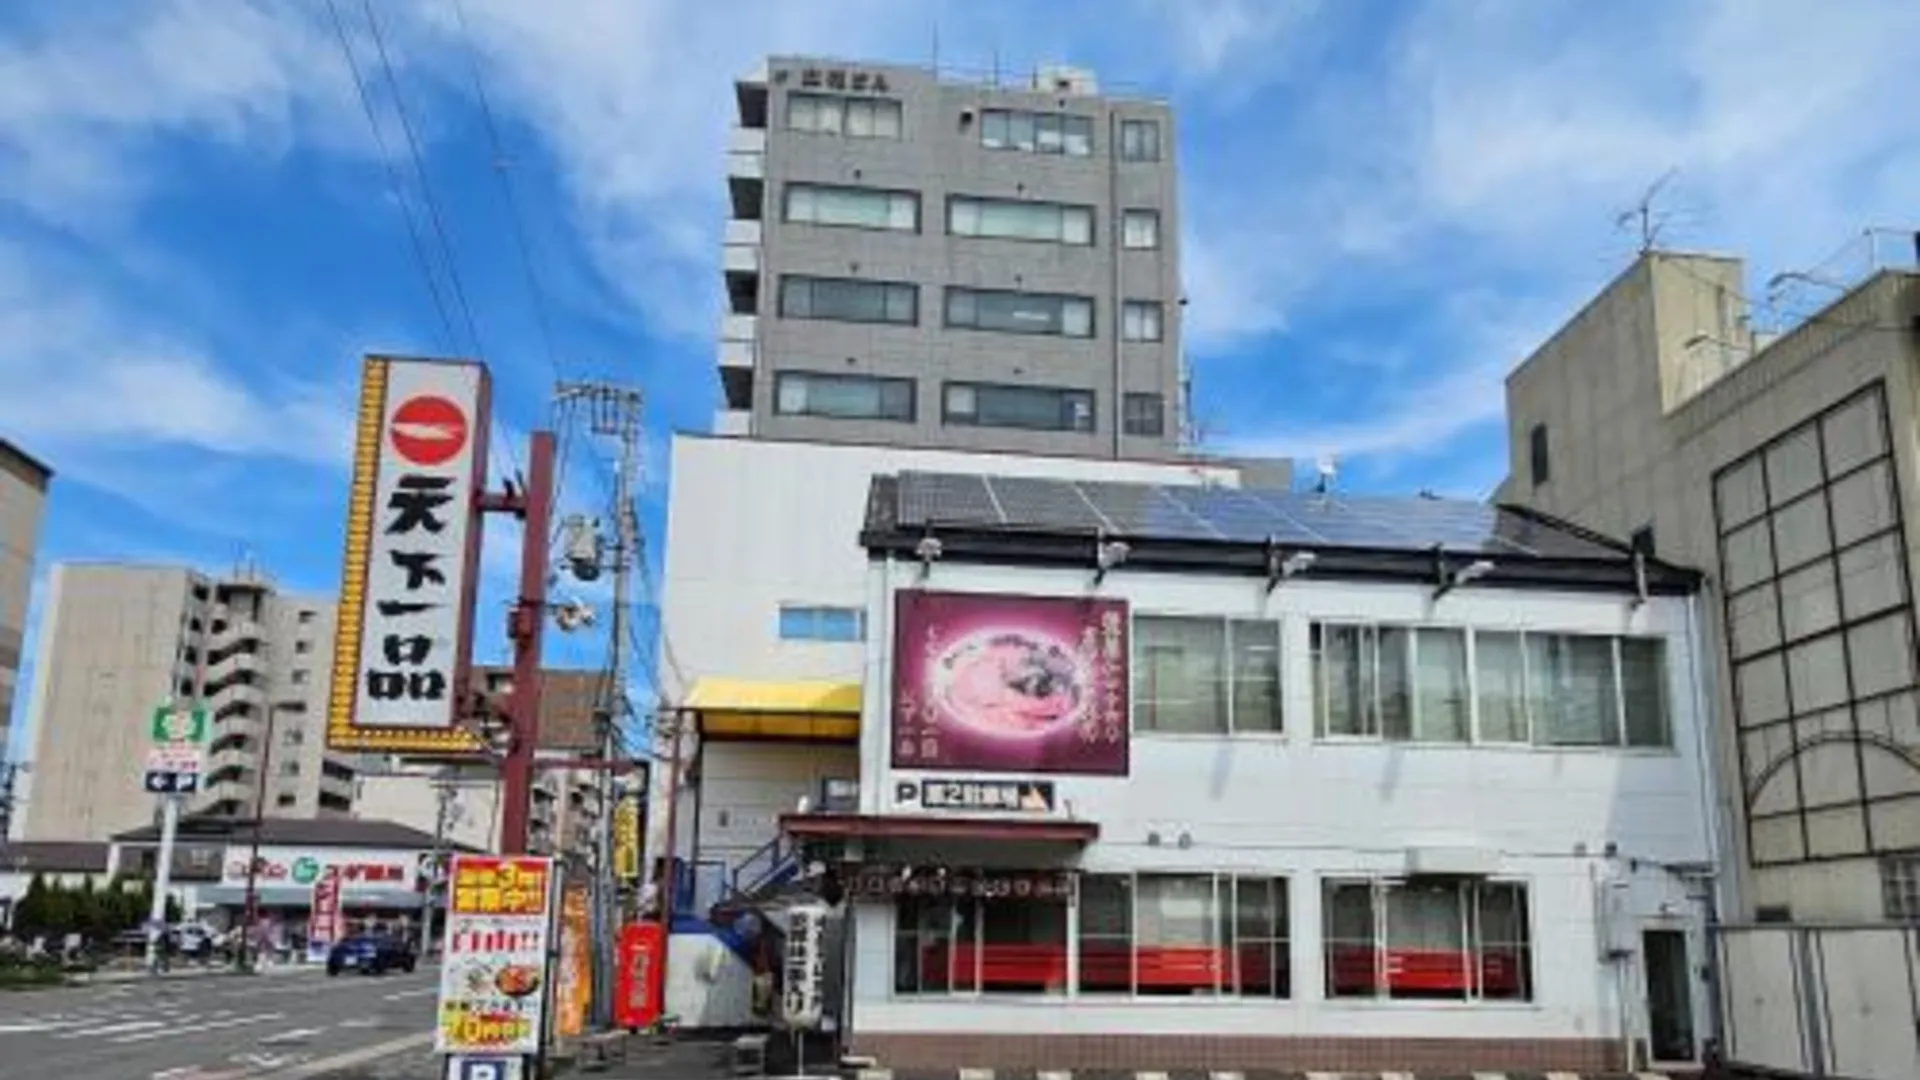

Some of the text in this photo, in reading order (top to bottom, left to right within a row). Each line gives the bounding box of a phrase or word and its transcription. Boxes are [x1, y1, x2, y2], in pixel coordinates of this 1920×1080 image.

[366, 474, 455, 700] 天下一品
[896, 781, 918, 803] P
